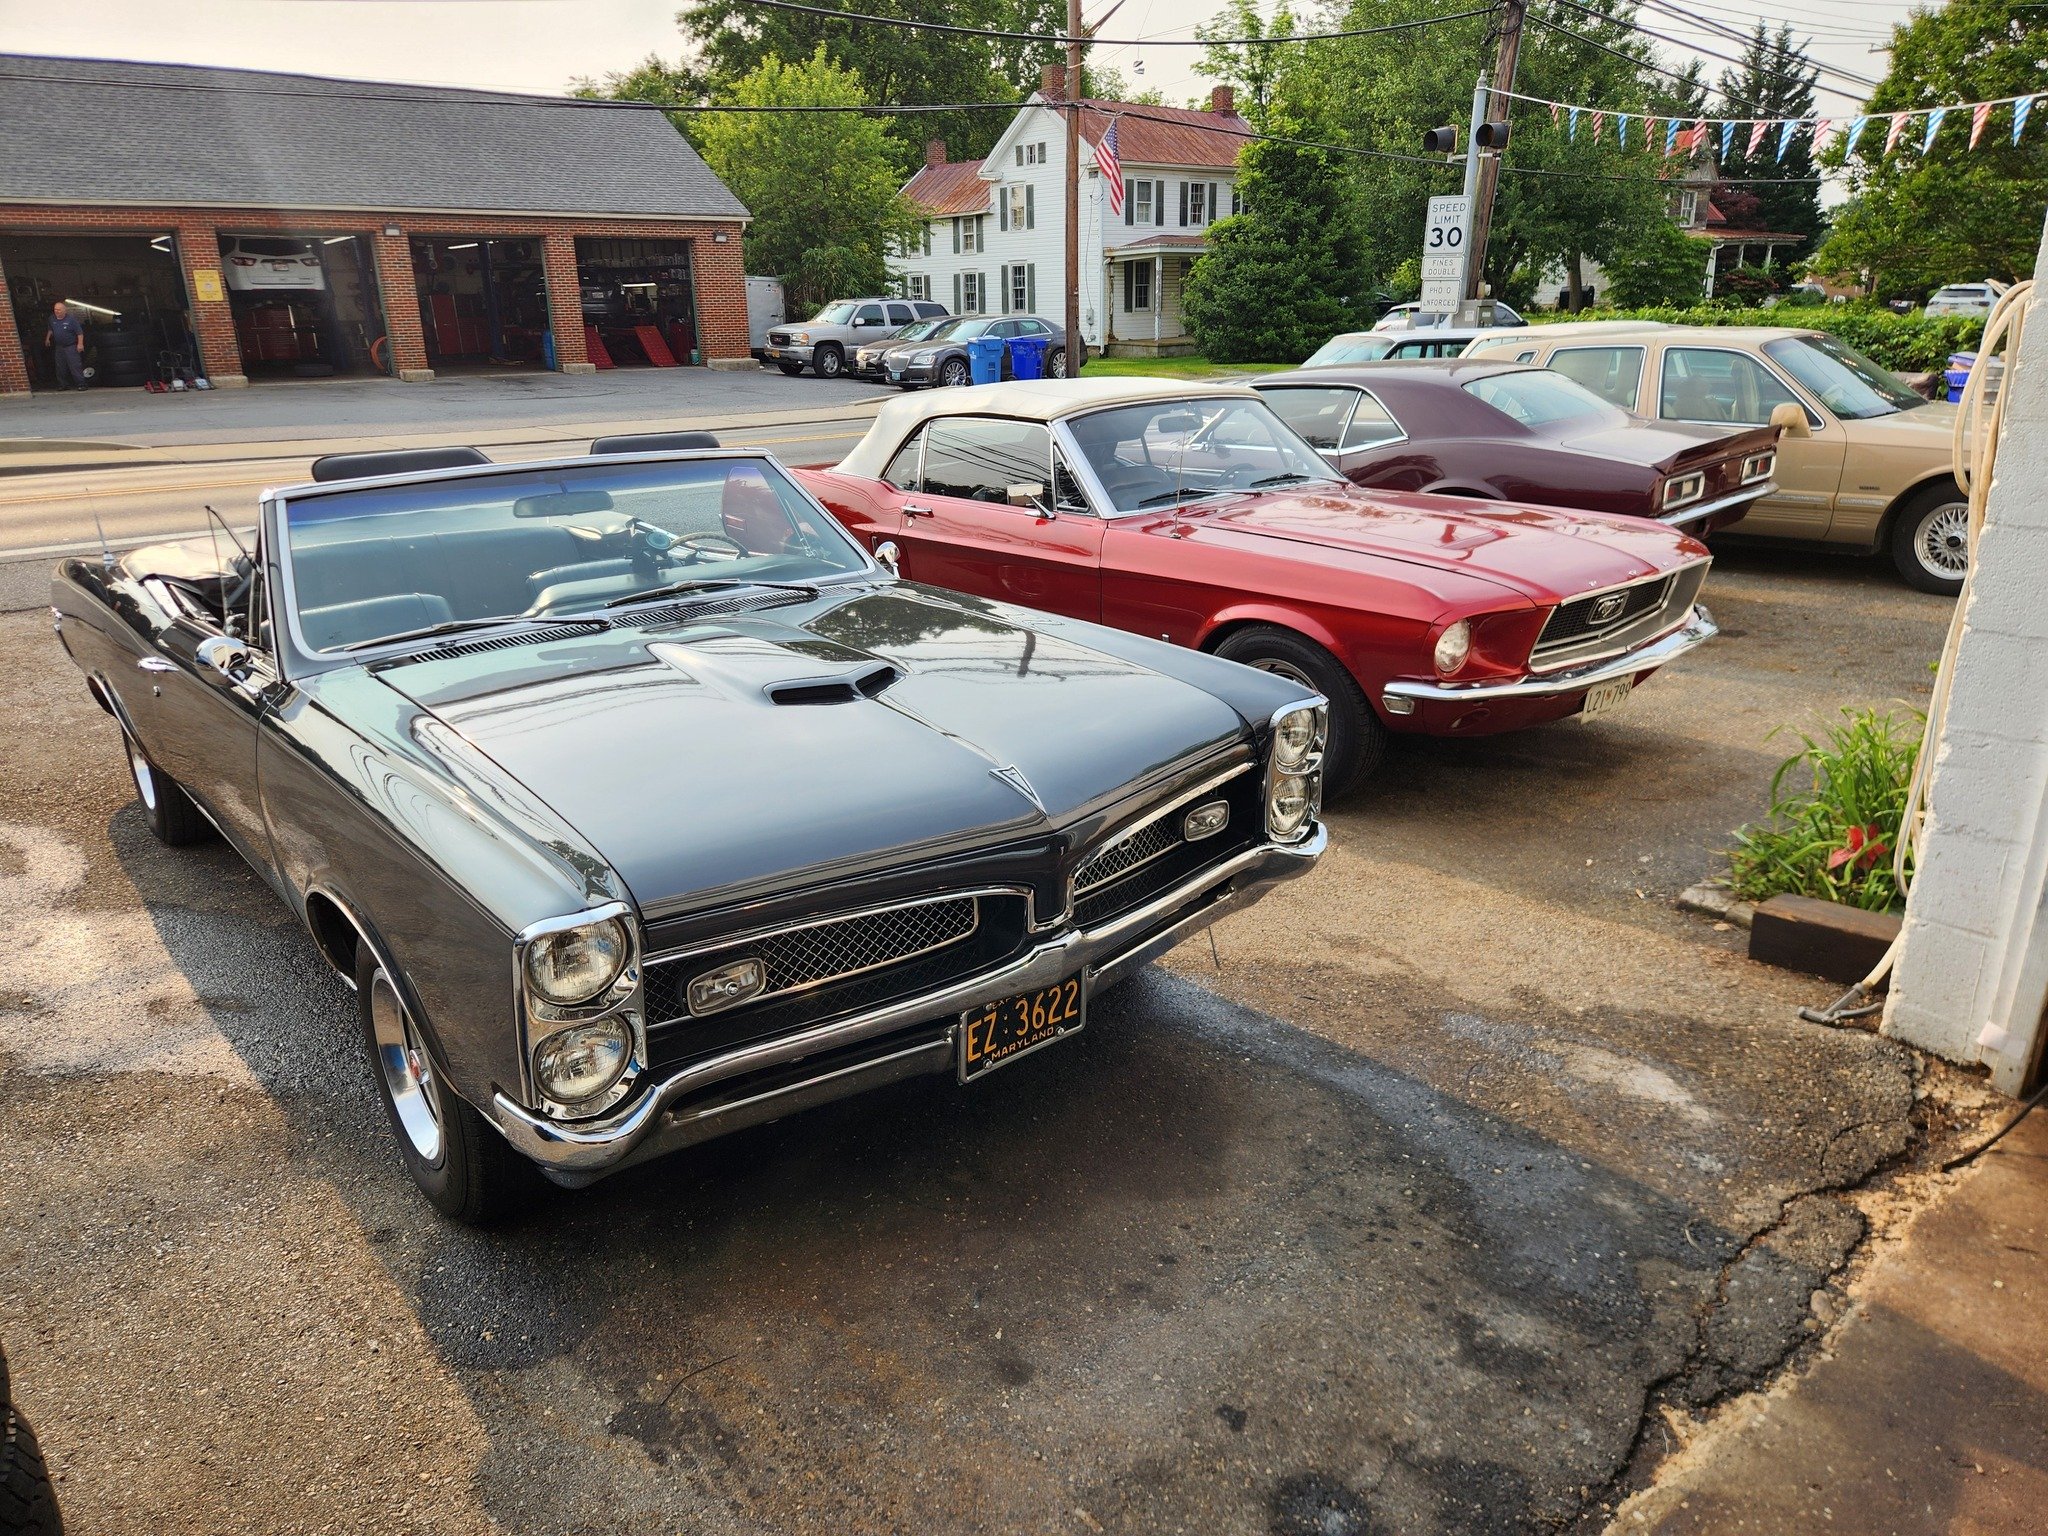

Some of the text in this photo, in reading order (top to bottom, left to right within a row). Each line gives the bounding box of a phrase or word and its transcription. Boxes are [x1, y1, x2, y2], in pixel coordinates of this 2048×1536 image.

[1432, 202, 1467, 213] SPEED
[1434, 215, 1461, 225] LIMIT
[1429, 226, 1463, 248] 30
[1432, 259, 1454, 267] FINES
[1428, 268, 1456, 276] DOUBLE
[991, 1026, 1054, 1060] MARYLAND
